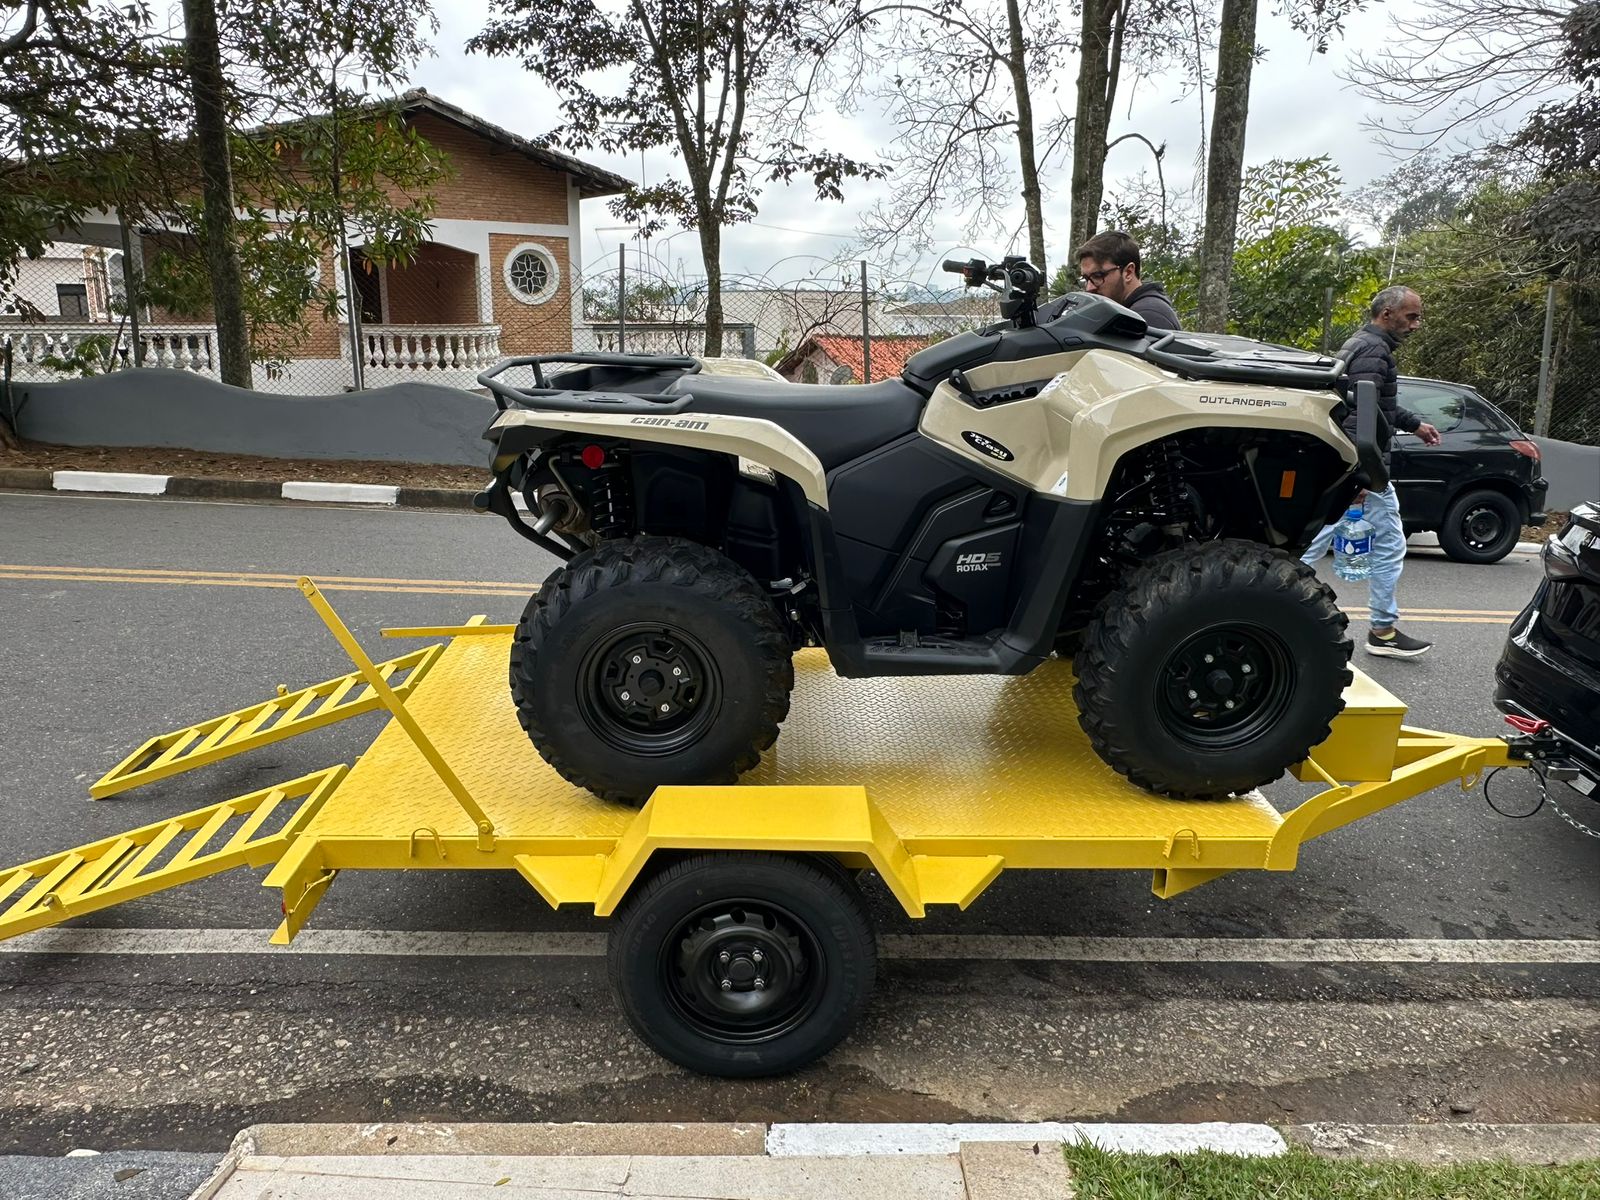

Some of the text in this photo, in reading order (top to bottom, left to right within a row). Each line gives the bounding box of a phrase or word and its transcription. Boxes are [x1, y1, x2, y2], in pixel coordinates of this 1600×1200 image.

[1199, 395, 1271, 407] OUTLANDER
[630, 417, 709, 430] can-am
[956, 563, 988, 572] ROTAX
